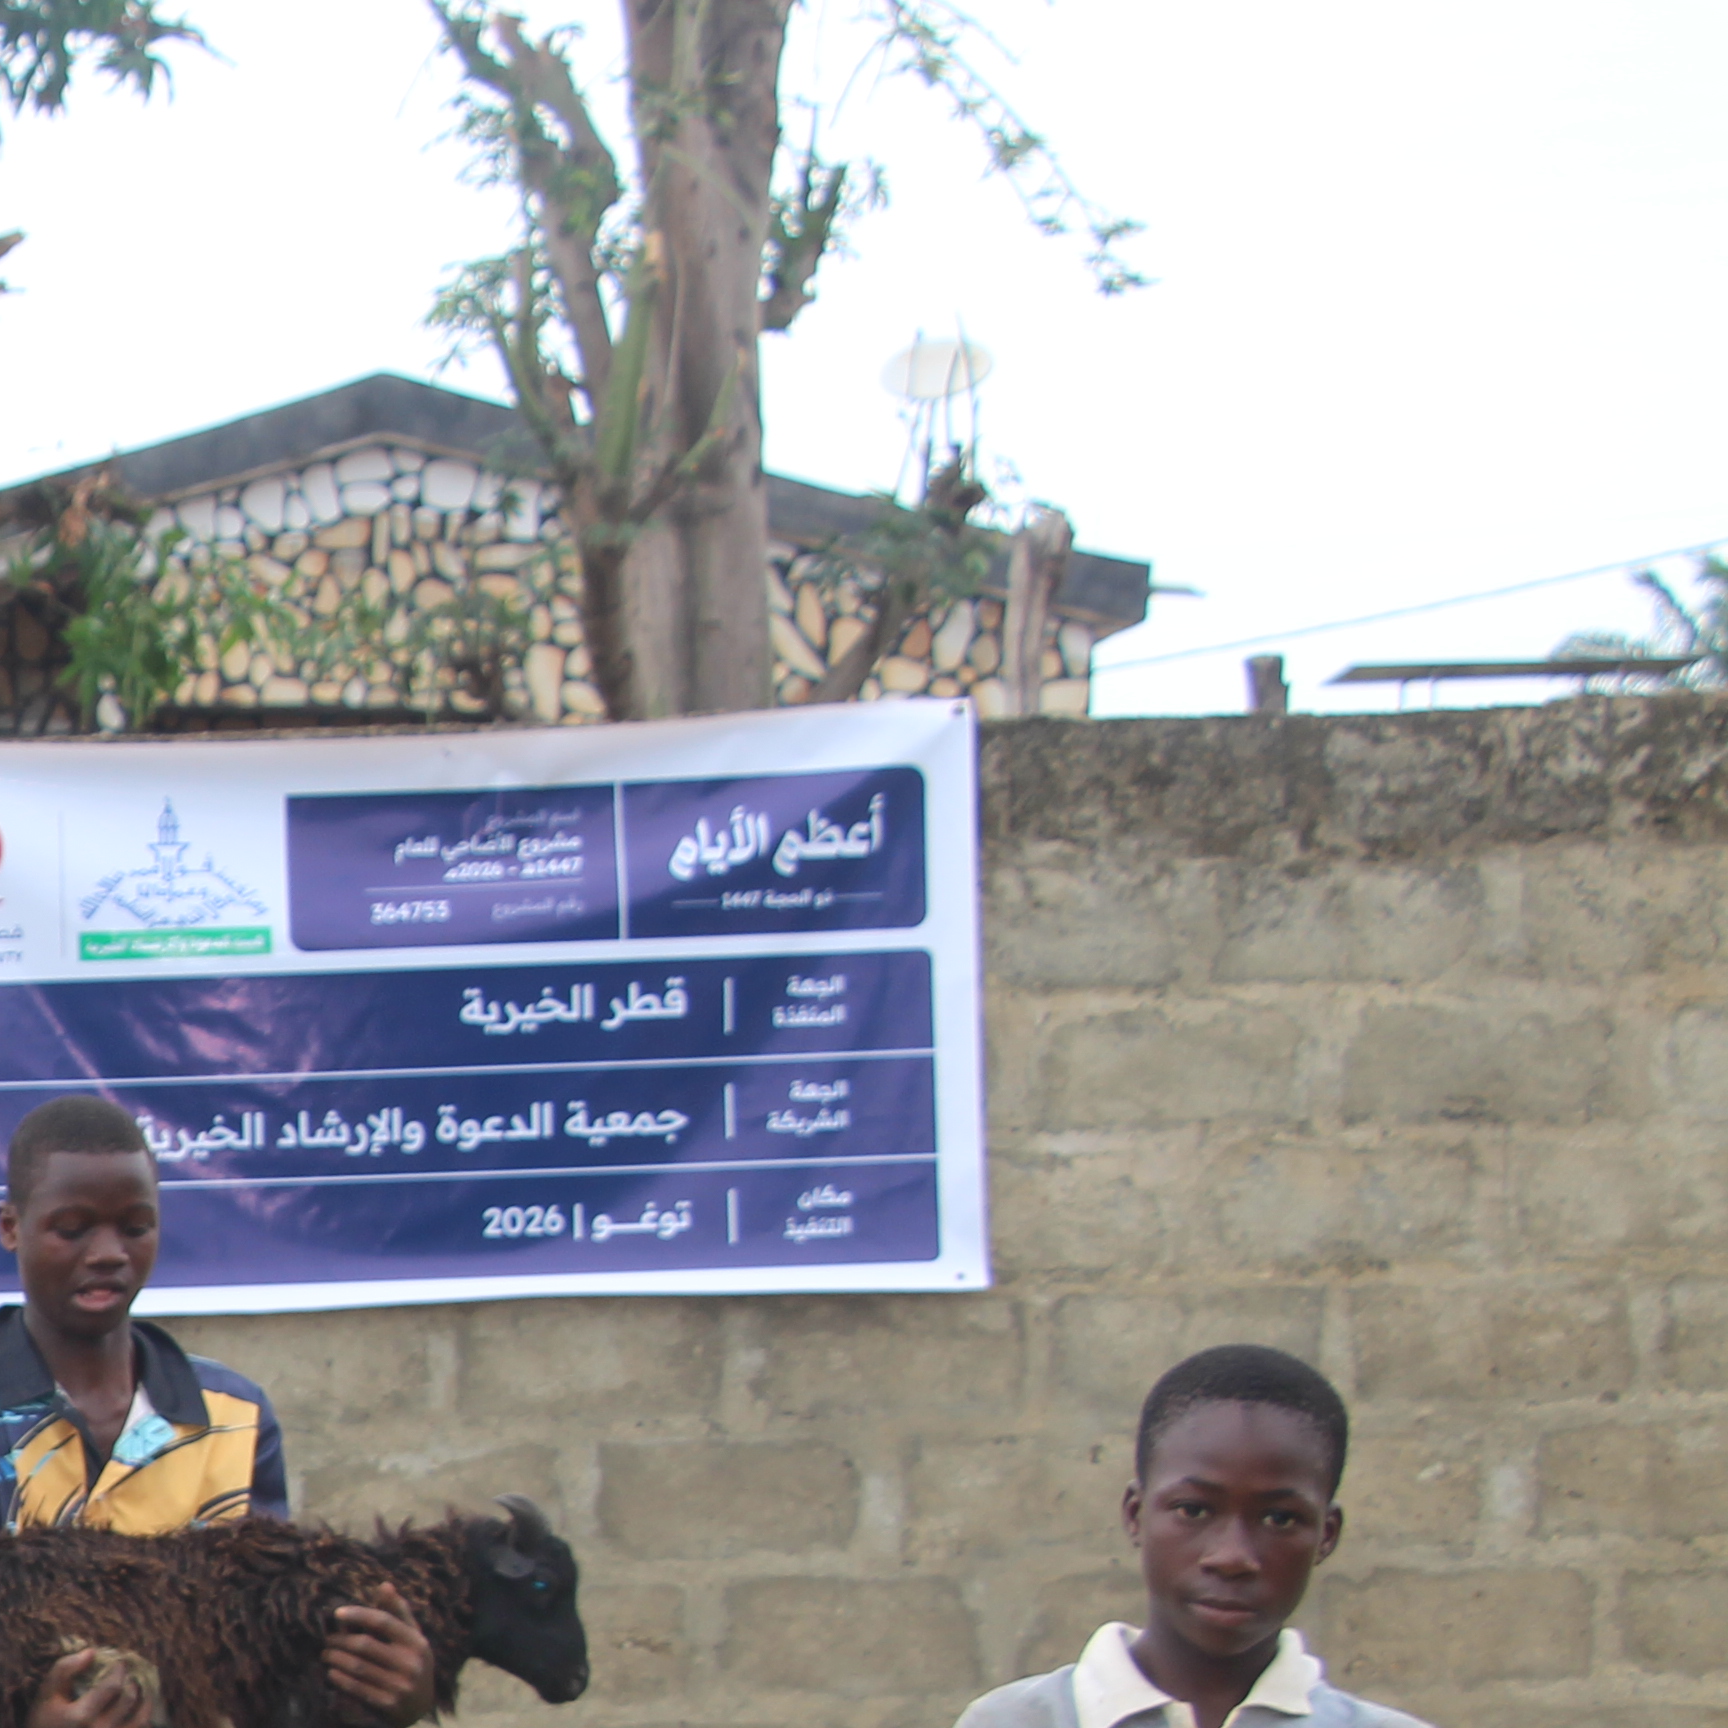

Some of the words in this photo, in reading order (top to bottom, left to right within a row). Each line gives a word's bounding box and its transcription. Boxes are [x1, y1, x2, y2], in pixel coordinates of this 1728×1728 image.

[517, 830, 583, 862] مشروع
[668, 804, 771, 882] الأيام
[772, 792, 885, 877] أعظم
[370, 900, 452, 925] 364753
[600, 976, 689, 1030] قطر
[786, 975, 847, 1000] الجهة
[459, 983, 594, 1034] الخيرية
[789, 1079, 849, 1104] الجهة
[135, 1111, 265, 1163] الخيرية
[276, 1106, 427, 1155] والإرشاد
[436, 1101, 555, 1151] الدعوة
[563, 1099, 690, 1145] جمعية
[766, 1108, 851, 1137] الشريكة
[797, 1184, 853, 1211] مكان
[482, 1205, 566, 1238] 2026
[783, 1216, 854, 1243] التنفيذ
